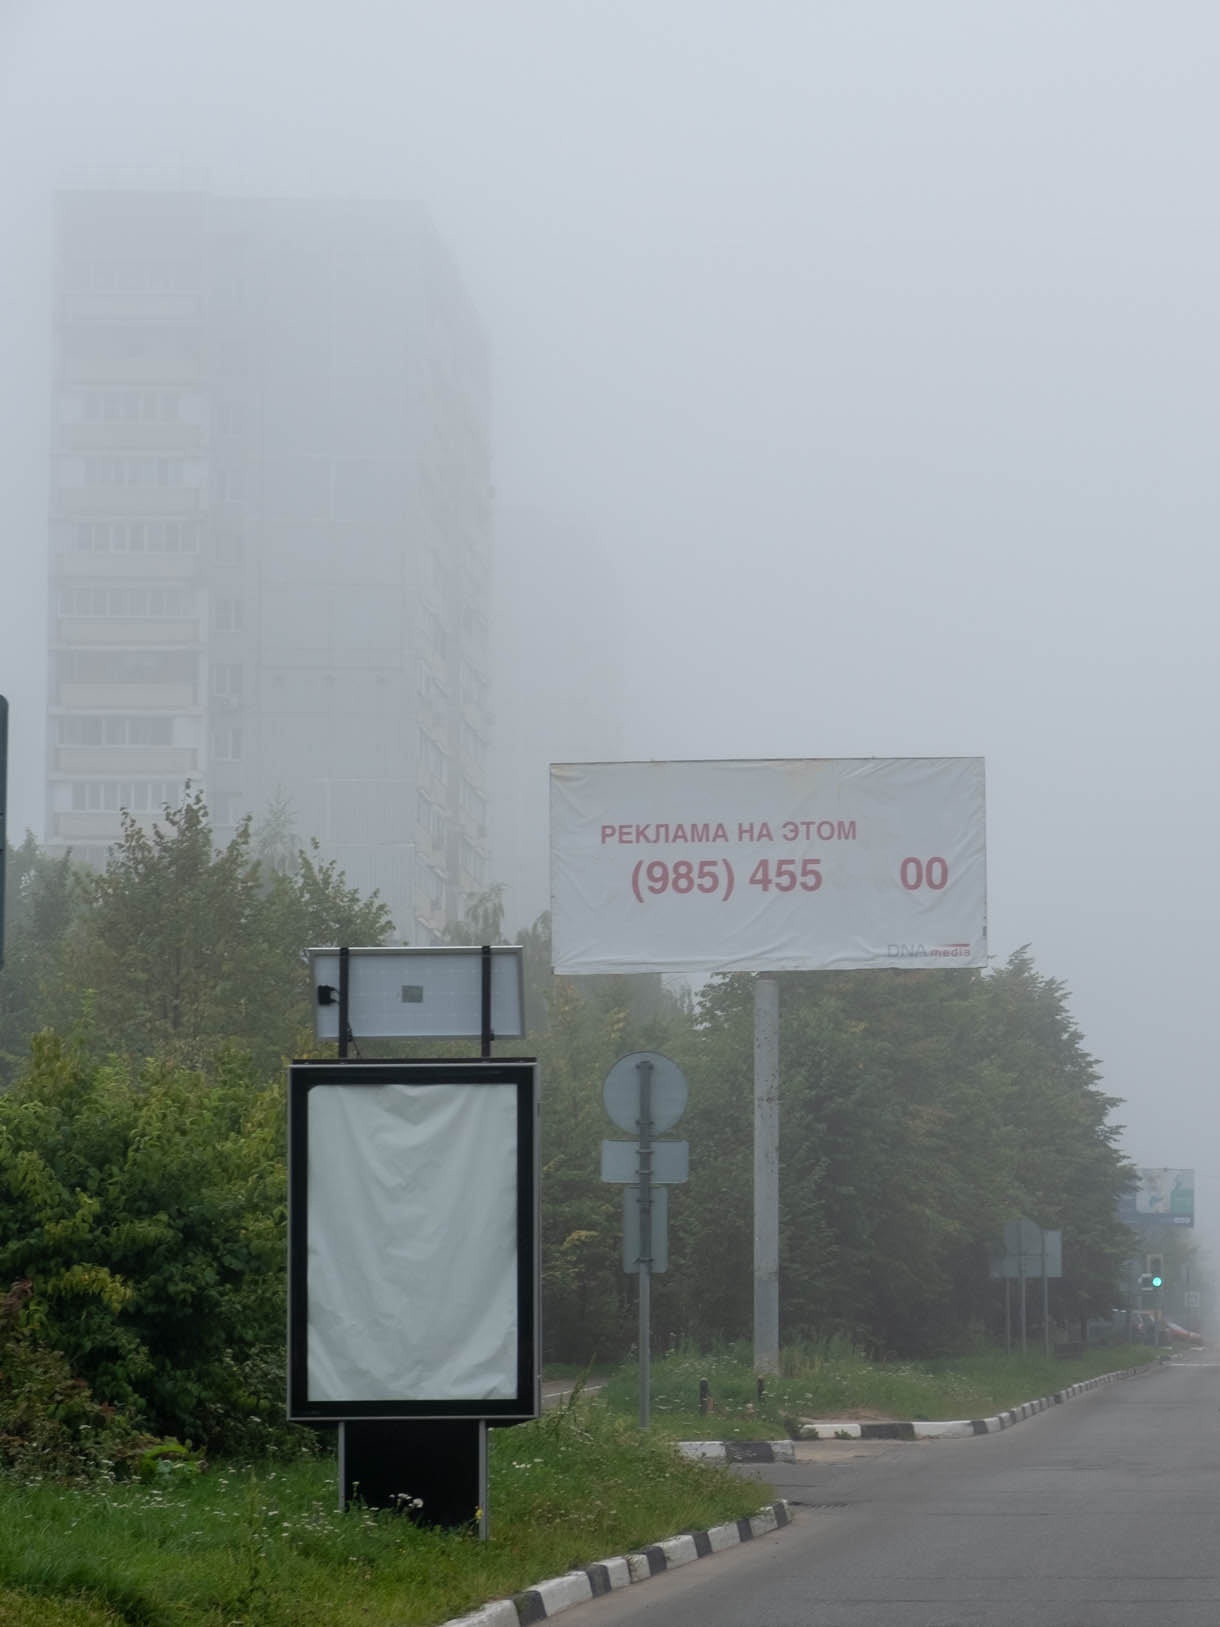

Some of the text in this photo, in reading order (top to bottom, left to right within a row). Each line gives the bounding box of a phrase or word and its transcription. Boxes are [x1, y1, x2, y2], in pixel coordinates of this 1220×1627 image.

[600, 820, 857, 845] РЕКЛАМА НА ЭТОМ
[631, 856, 949, 902] (985) 455 00
[887, 944, 929, 958] DNA
